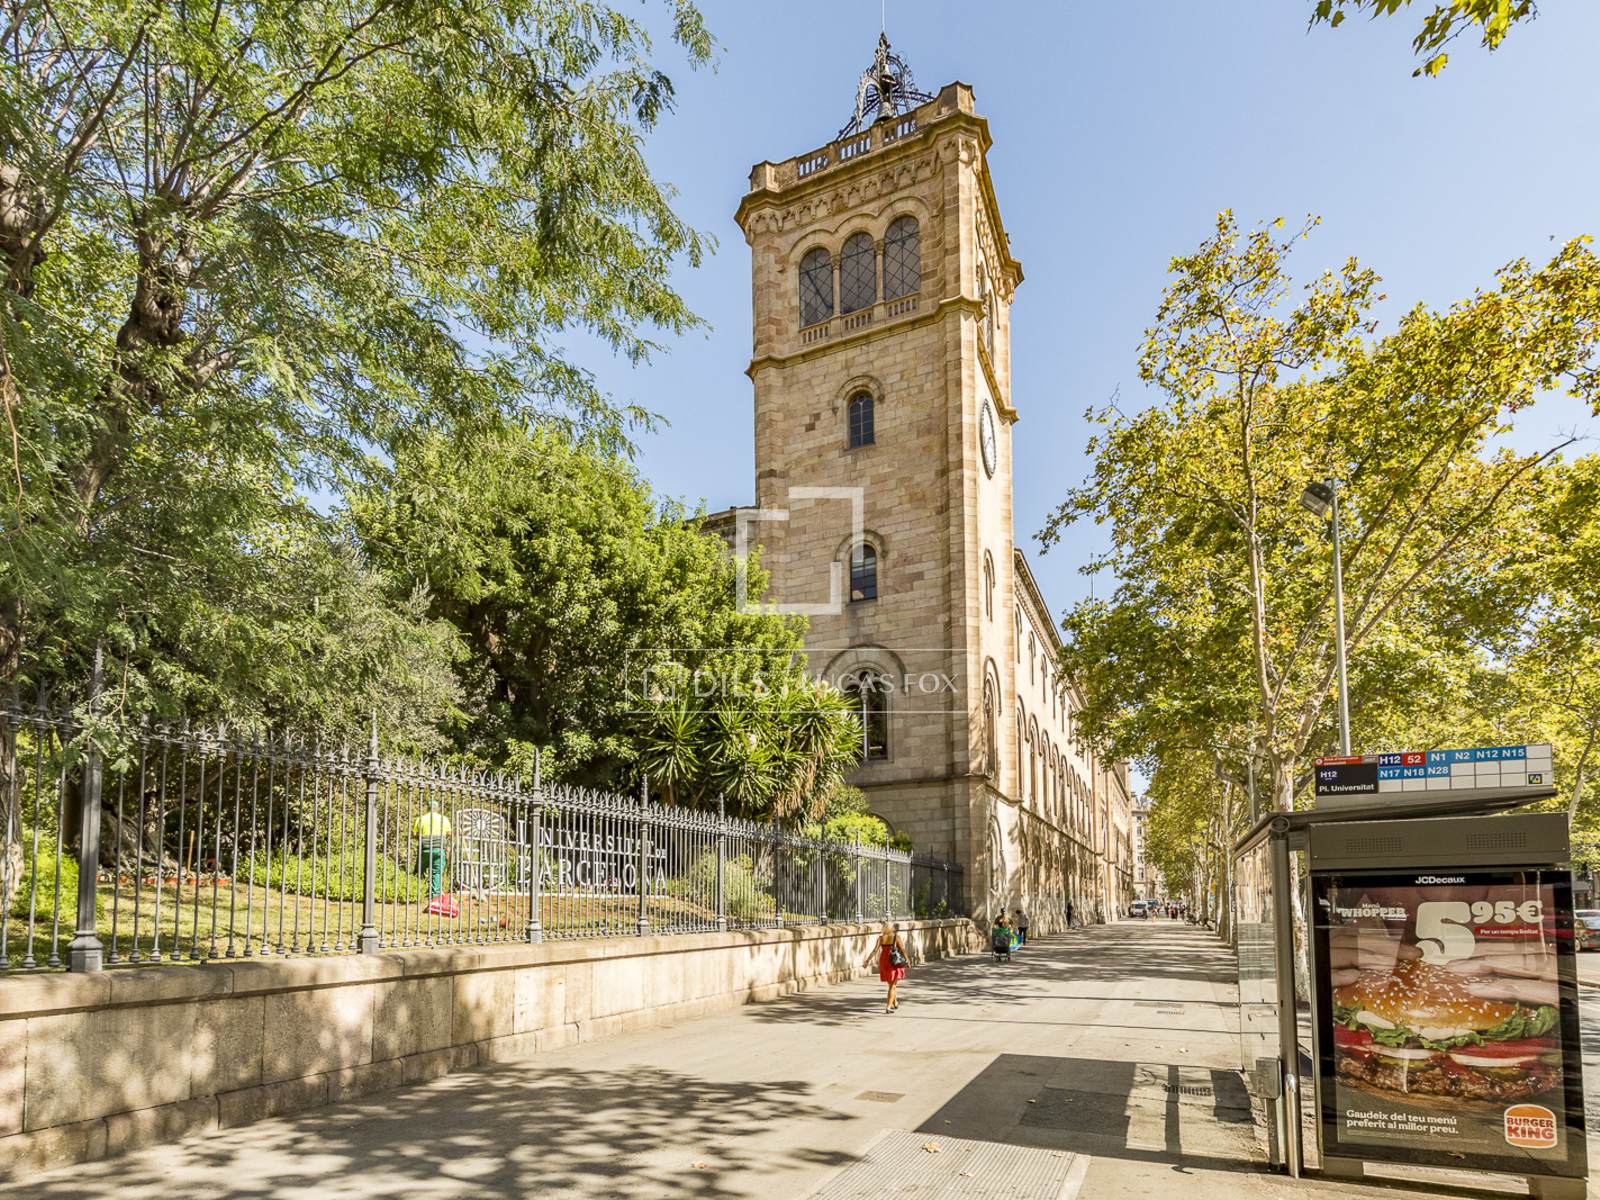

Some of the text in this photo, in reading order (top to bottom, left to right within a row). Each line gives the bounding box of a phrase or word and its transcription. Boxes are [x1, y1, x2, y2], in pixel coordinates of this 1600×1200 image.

[1379, 748, 1526, 765] H12 52 N1 N2 N12 N15
[1380, 766, 1449, 778] N17 N18 N28
[1331, 783, 1375, 792] Universitat
[517, 855, 669, 891] BARCELOA
[1415, 876, 1466, 884] JCDecaux
[1346, 1109, 1389, 1120] Gaudeix
[1390, 1112, 1406, 1121] del
[1427, 1115, 1457, 1125] menú
[1507, 1117, 1554, 1128] BURGER
[1346, 1119, 1385, 1129] preferit
[1398, 1122, 1428, 1131] millor
[1507, 1126, 1555, 1140] KING
